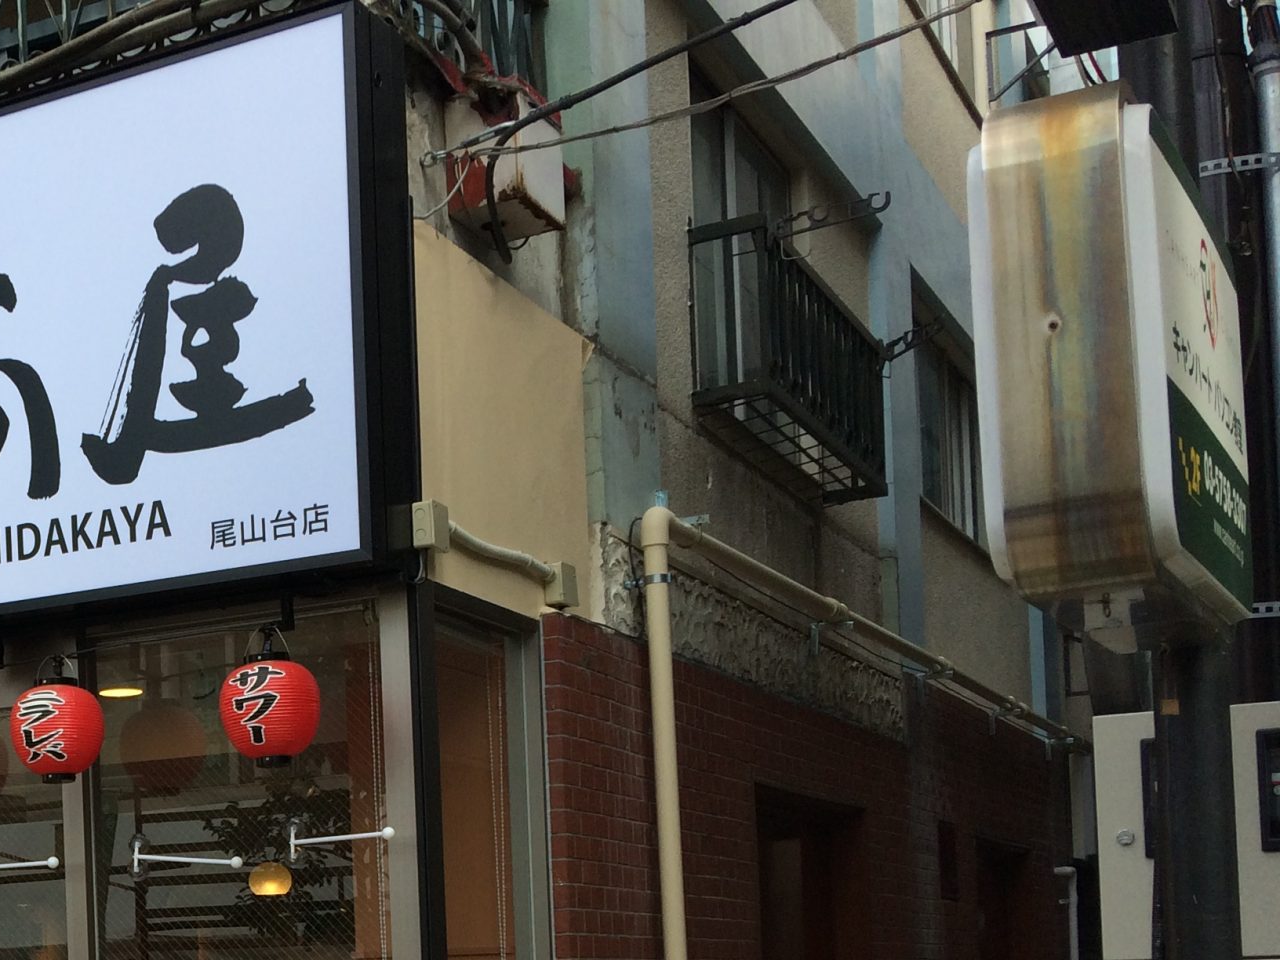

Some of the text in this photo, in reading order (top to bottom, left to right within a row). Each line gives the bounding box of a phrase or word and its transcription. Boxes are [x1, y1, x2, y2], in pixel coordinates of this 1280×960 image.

[209, 503, 331, 551] 尾山台店
[16, 689, 67, 763] ニラレバ
[228, 664, 287, 746] サワー
